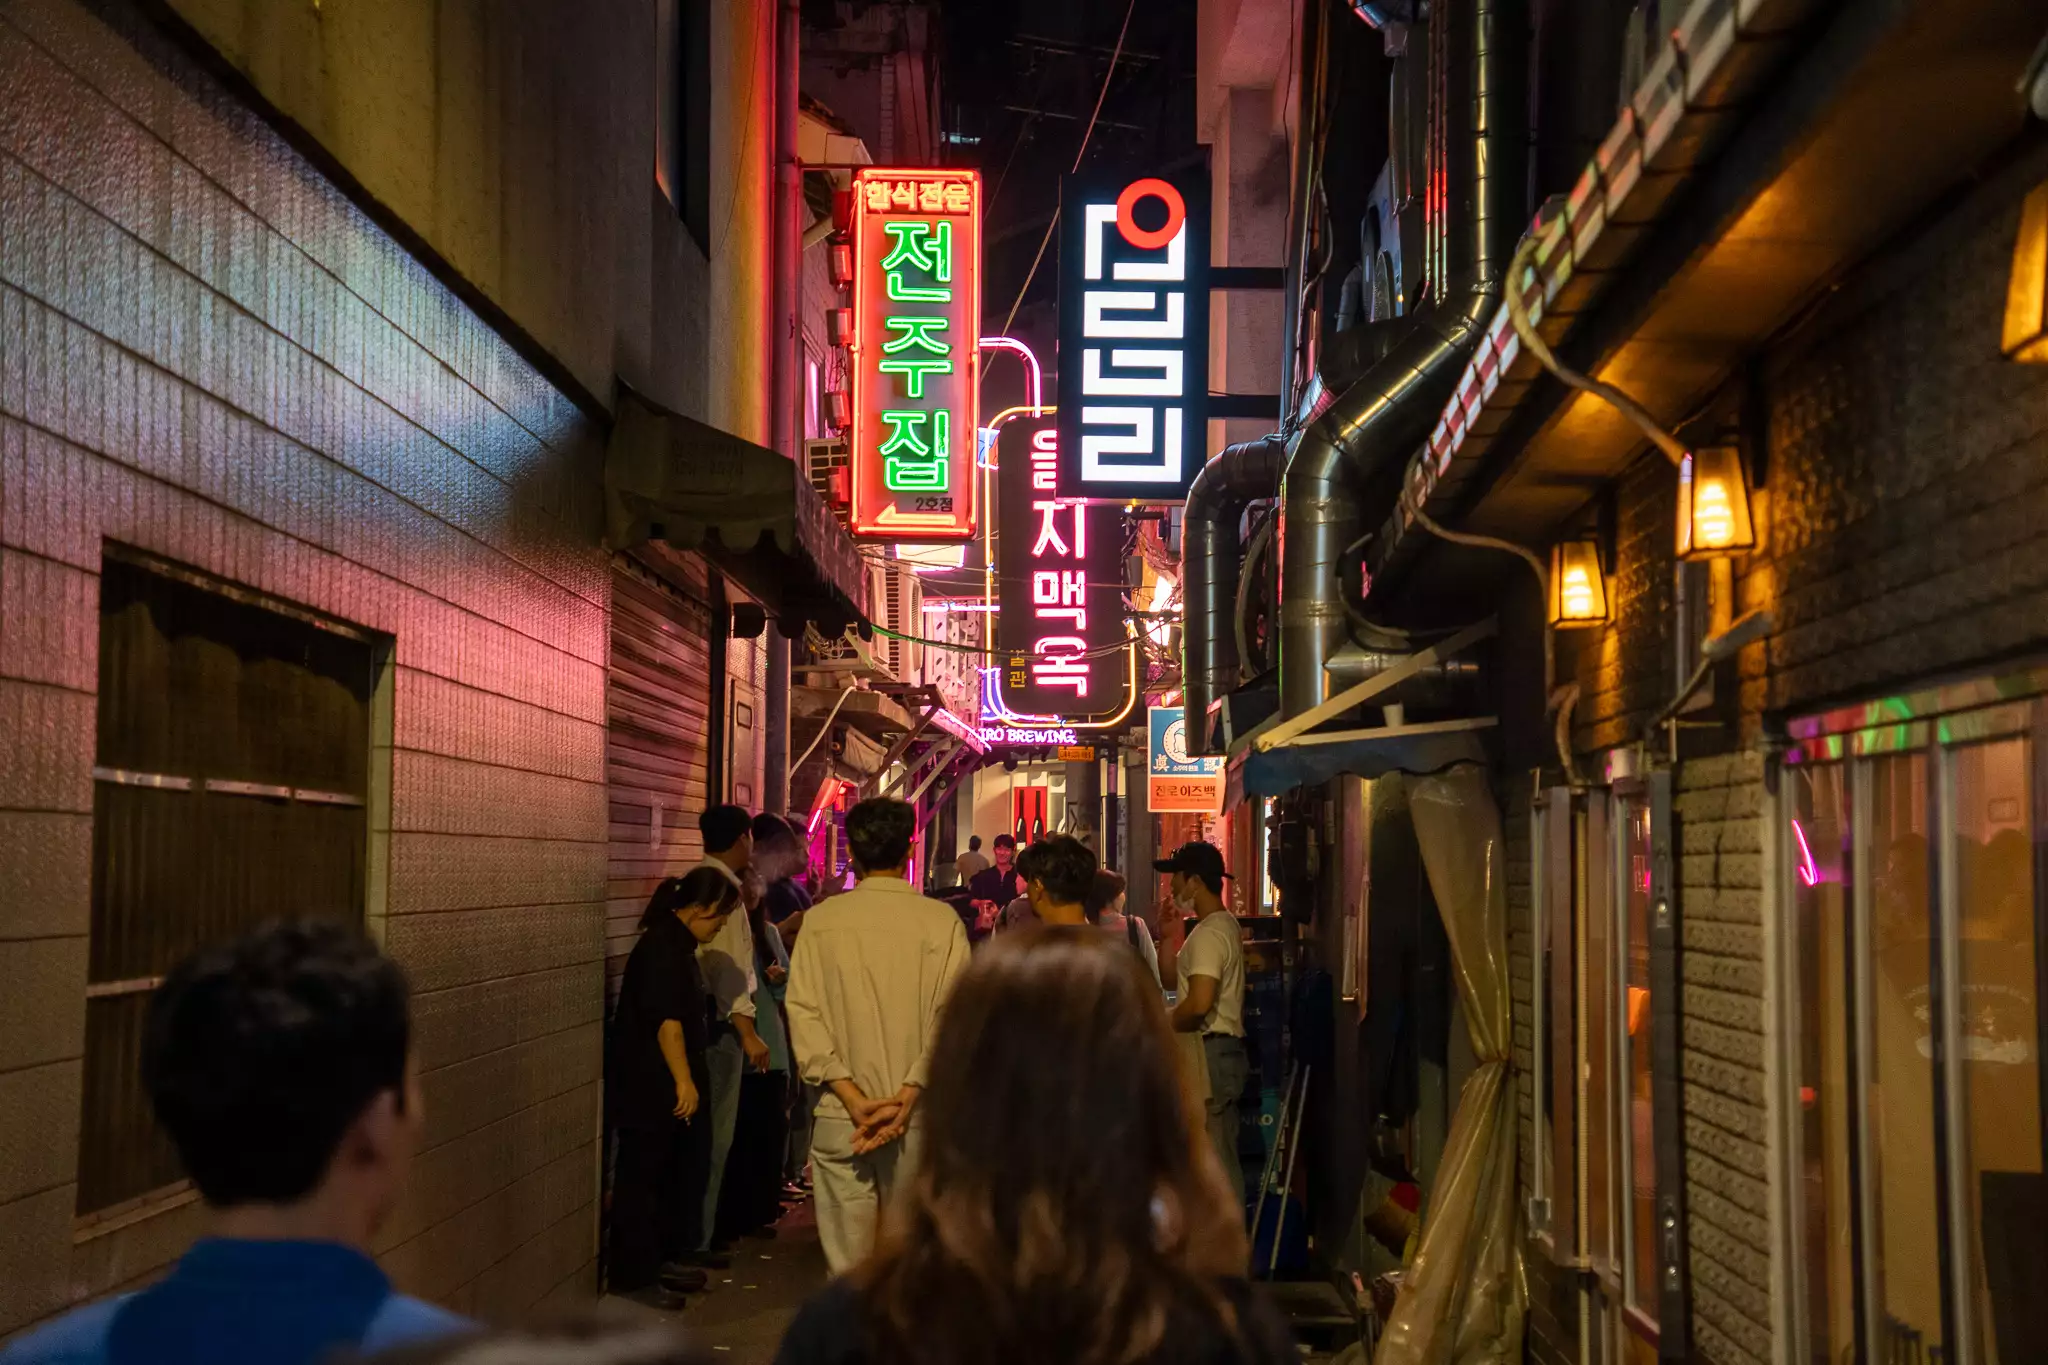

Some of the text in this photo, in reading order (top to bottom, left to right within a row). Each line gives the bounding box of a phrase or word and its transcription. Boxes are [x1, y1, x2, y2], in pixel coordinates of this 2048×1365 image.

[865, 180, 970, 212] 한식전문
[879, 221, 953, 492] 전주집
[915, 496, 953, 512] 2호점
[1006, 728, 1078, 745] BREWING
